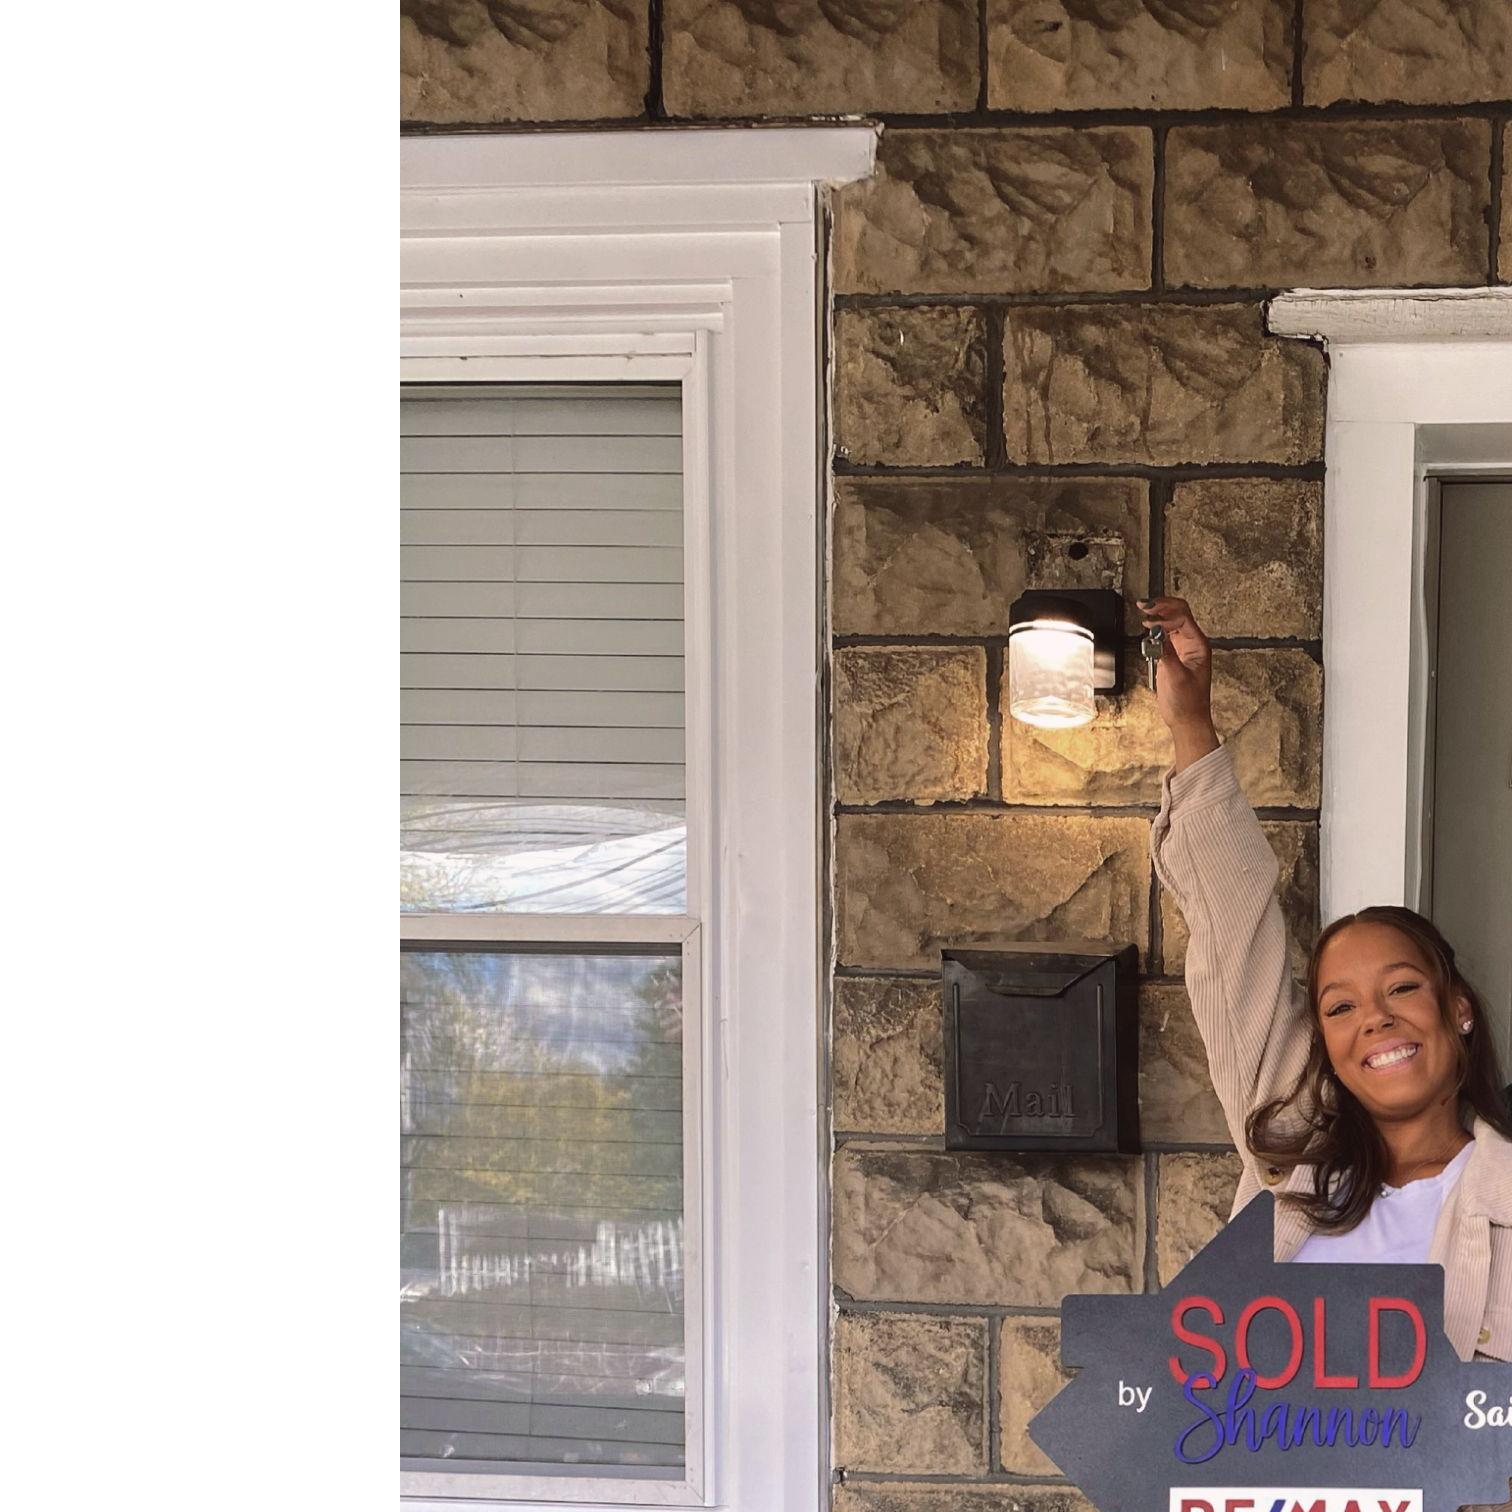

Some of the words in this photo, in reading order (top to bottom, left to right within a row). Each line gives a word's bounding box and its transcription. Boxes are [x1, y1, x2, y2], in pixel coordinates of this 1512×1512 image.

[983, 1080, 1078, 1118] Mail
[1168, 1295, 1428, 1390] SOLD
[1117, 1380, 1153, 1413] by
[1173, 1367, 1422, 1465] Shannon
